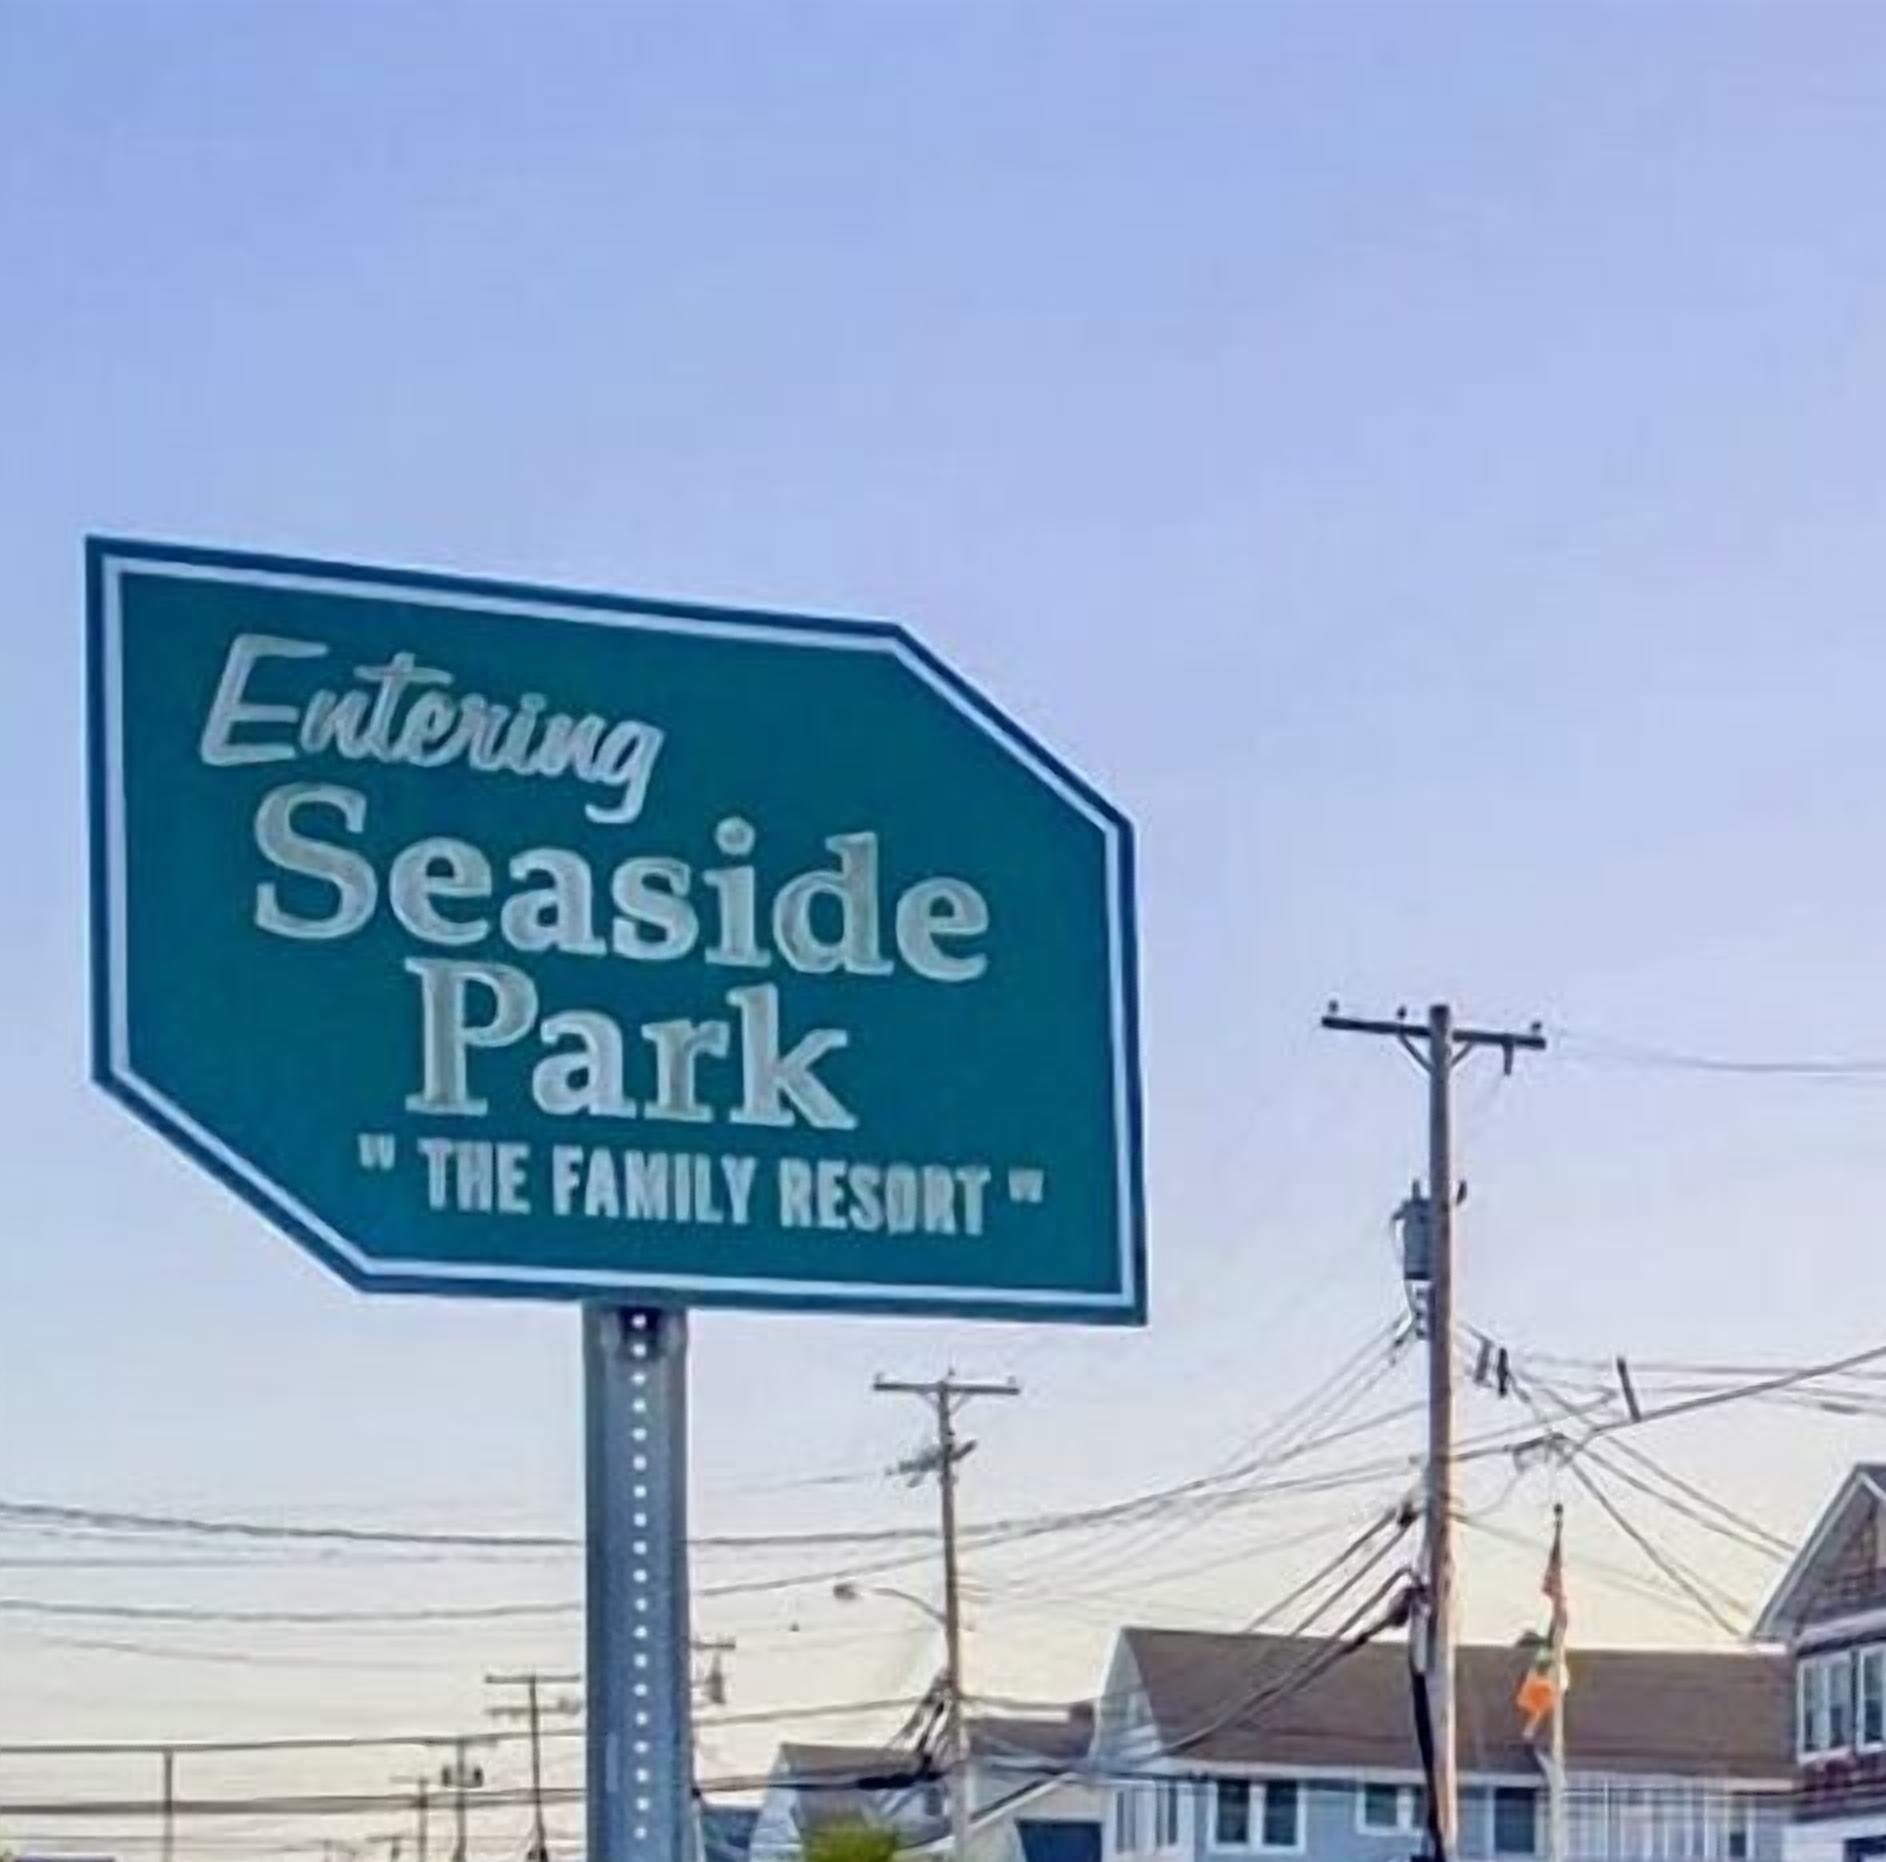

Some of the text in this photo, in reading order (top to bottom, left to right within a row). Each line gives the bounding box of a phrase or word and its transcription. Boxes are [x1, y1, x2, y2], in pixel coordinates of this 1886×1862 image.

[199, 633, 665, 824] Entering
[253, 781, 990, 983] Seaside
[404, 955, 857, 1131] Park
[418, 1137, 530, 1215] THE
[551, 1146, 757, 1226] FAMILY
[778, 1161, 991, 1236] RESORT
